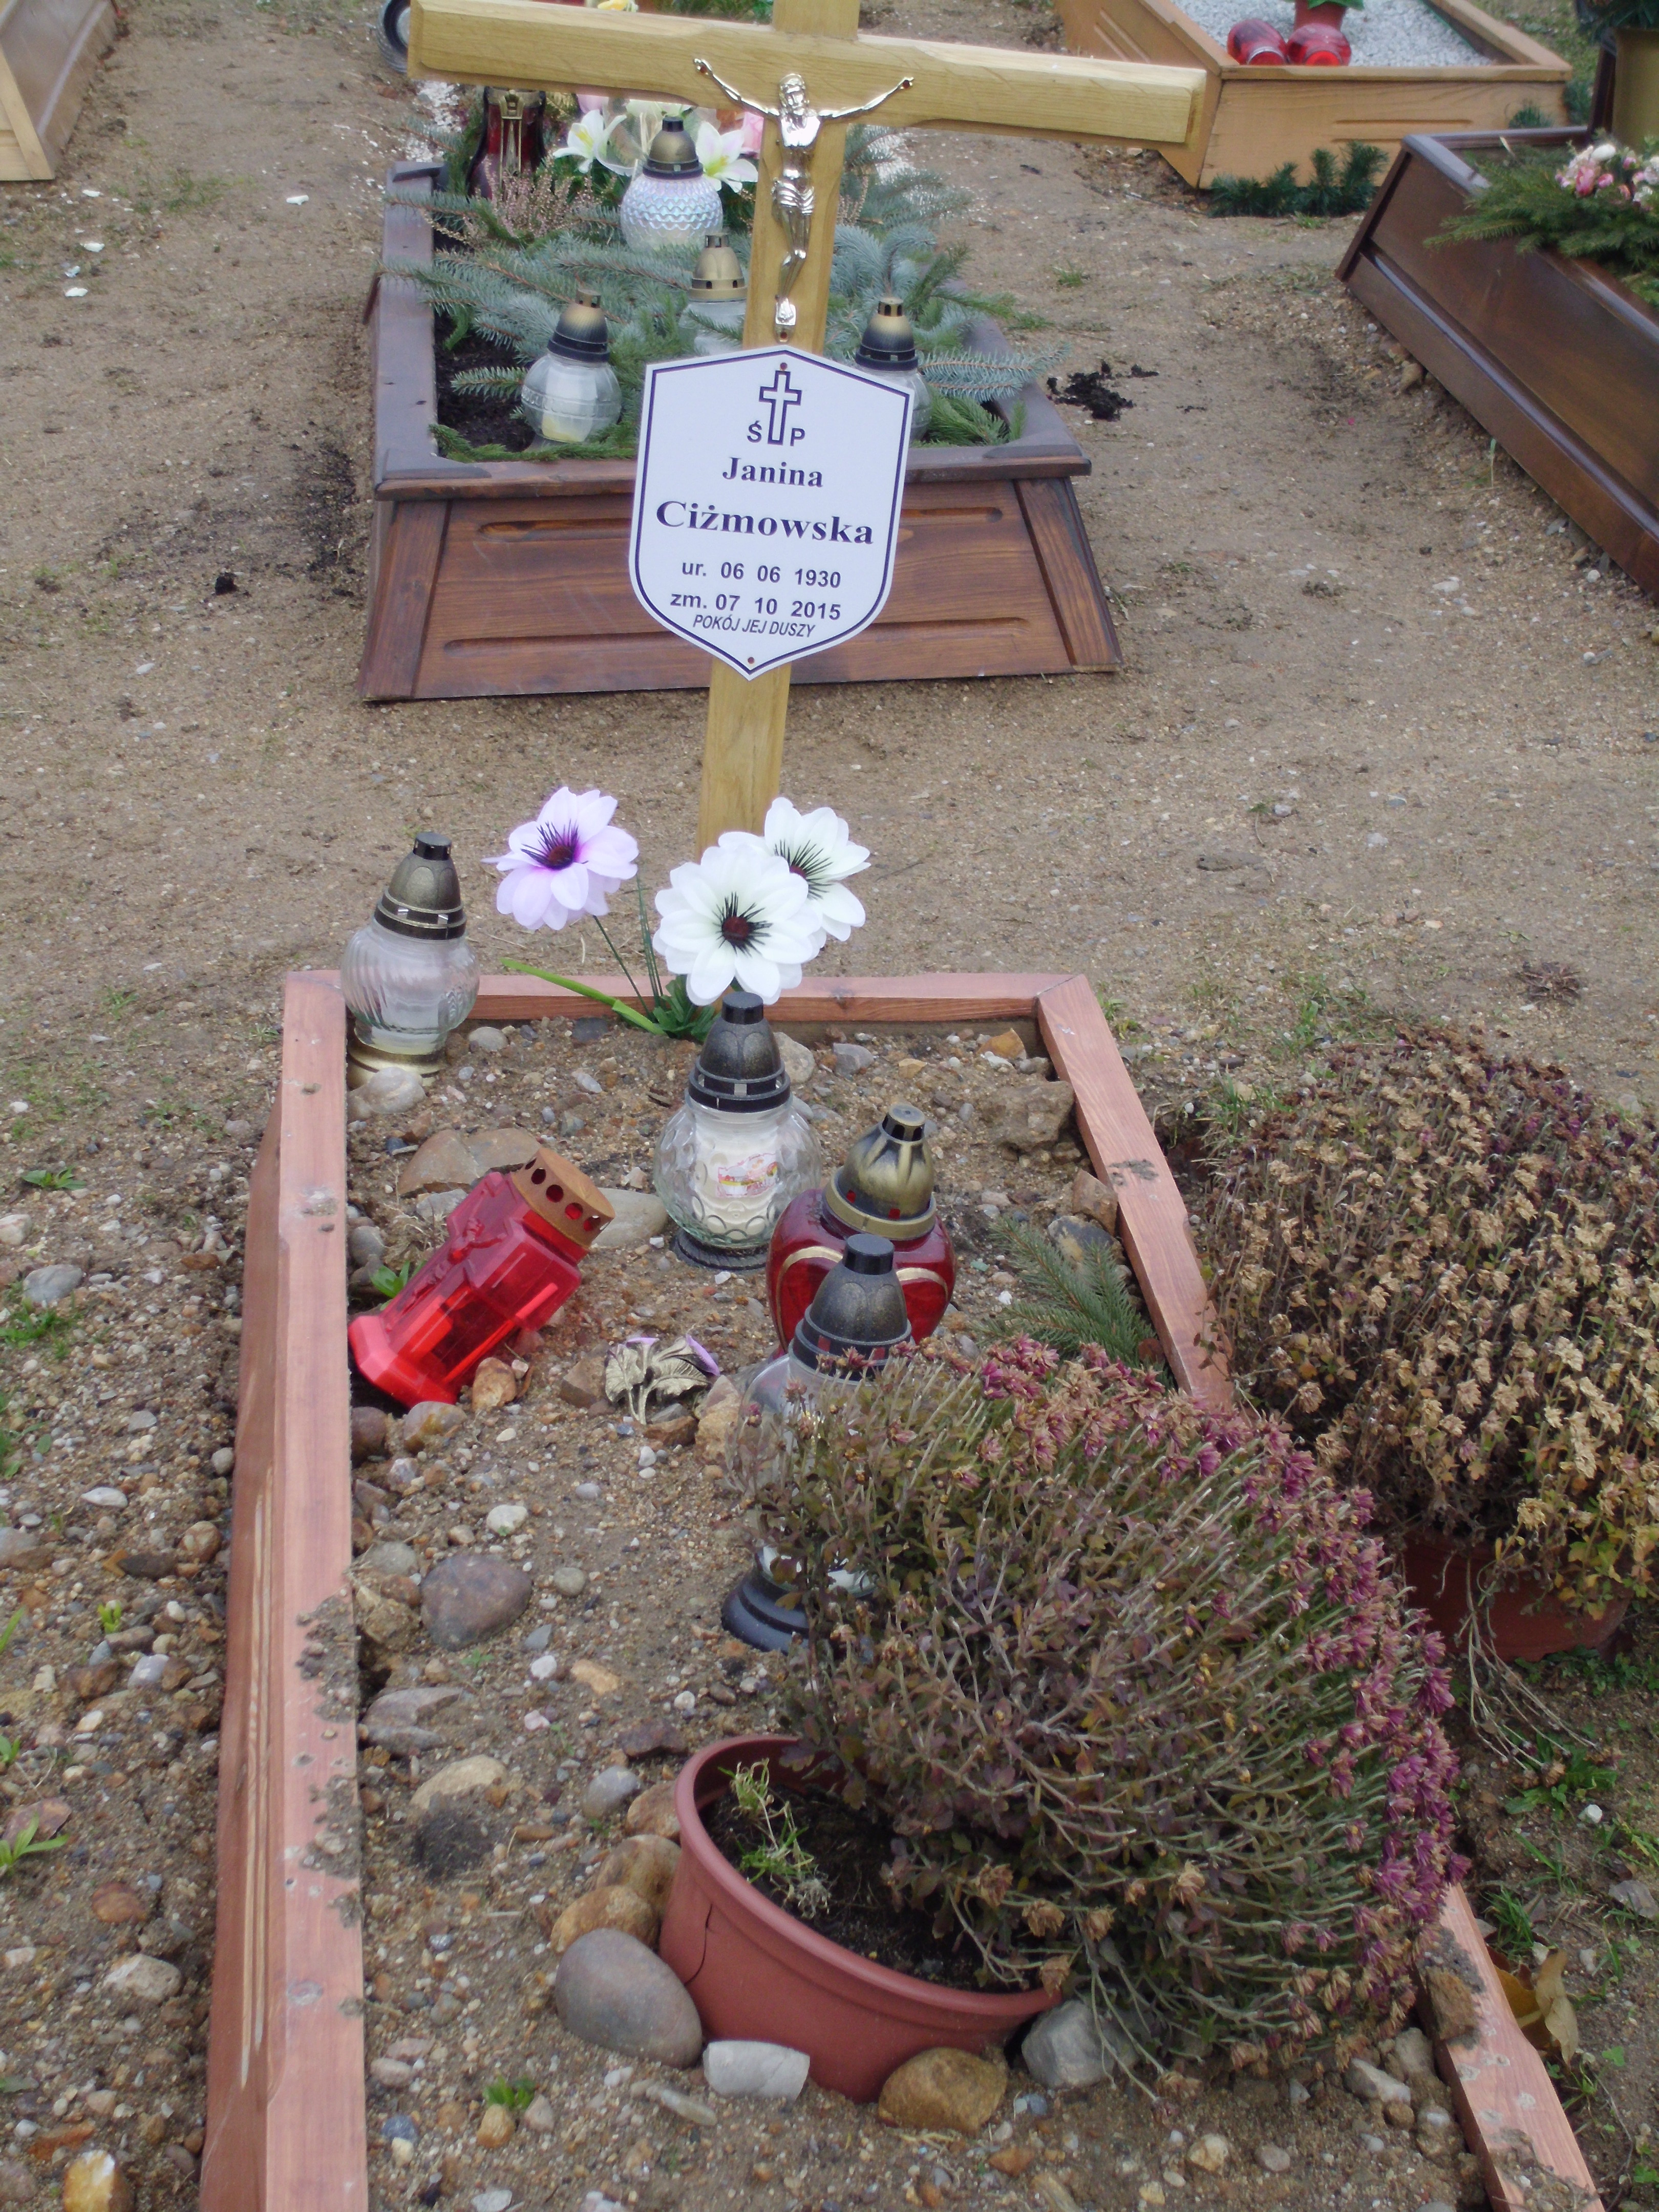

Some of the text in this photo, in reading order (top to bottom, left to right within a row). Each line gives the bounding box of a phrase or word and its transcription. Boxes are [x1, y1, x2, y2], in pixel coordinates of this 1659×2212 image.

[747, 420, 805, 446] Ś P
[722, 457, 822, 487] Janina
[656, 501, 873, 544] Ciżmowska
[682, 562, 841, 588] ur. 06 06 1930
[670, 593, 841, 620] zm. 07 10 2015
[693, 614, 816, 637] POKÓJ JEJ DUSZY
